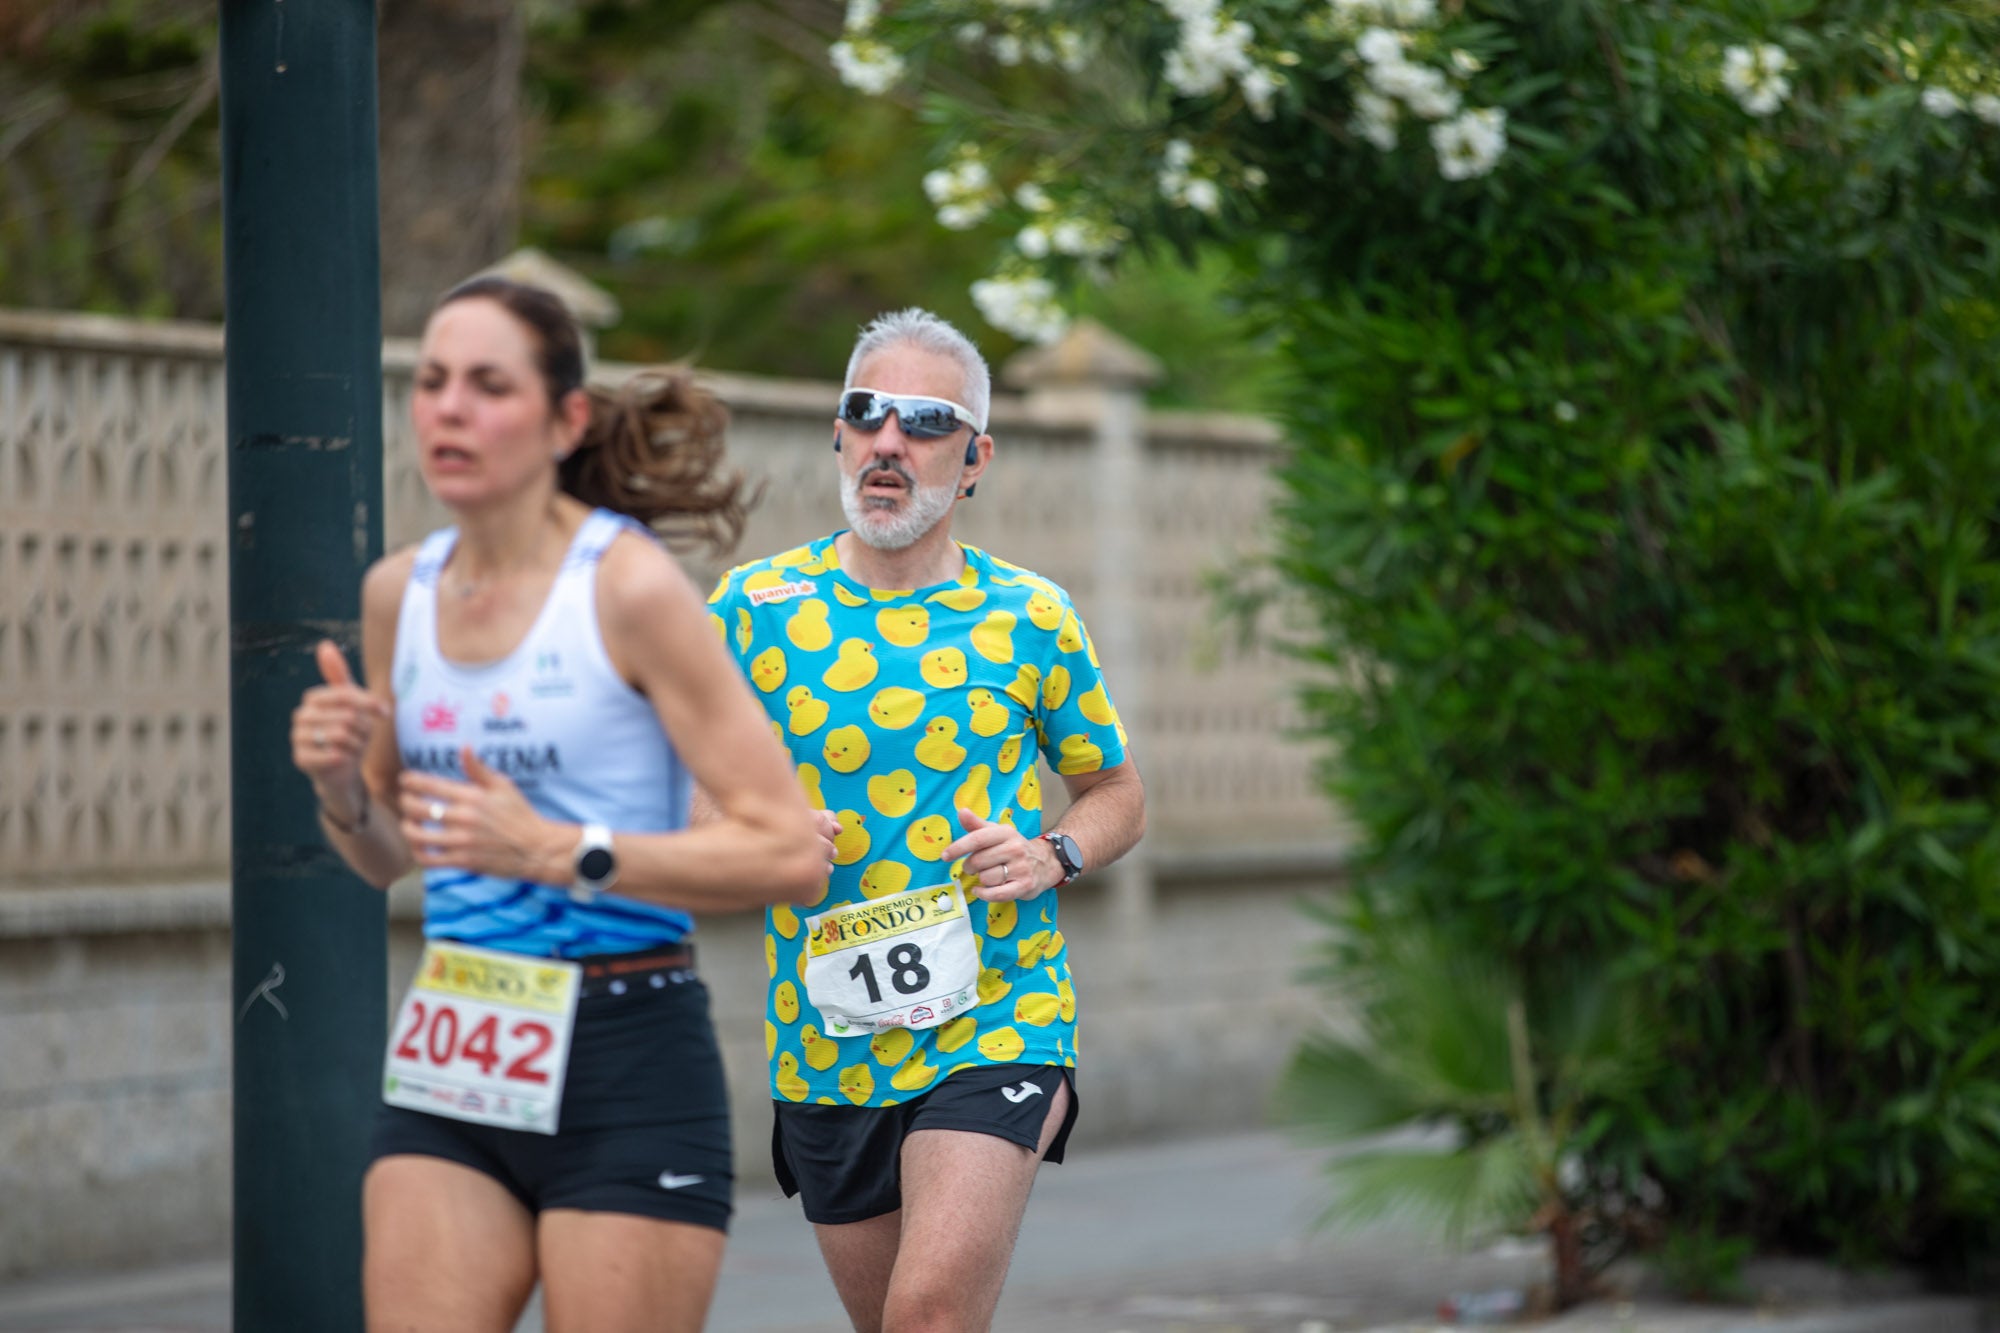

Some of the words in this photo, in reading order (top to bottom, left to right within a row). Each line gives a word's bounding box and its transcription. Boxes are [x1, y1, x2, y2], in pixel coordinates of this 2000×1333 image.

[403, 744, 560, 771] MARCENA
[838, 905, 925, 941] FONDO
[840, 906, 871, 923] GRAN
[872, 898, 914, 915] PREMIO
[848, 943, 931, 1003] 18
[395, 1001, 554, 1085] 2042
